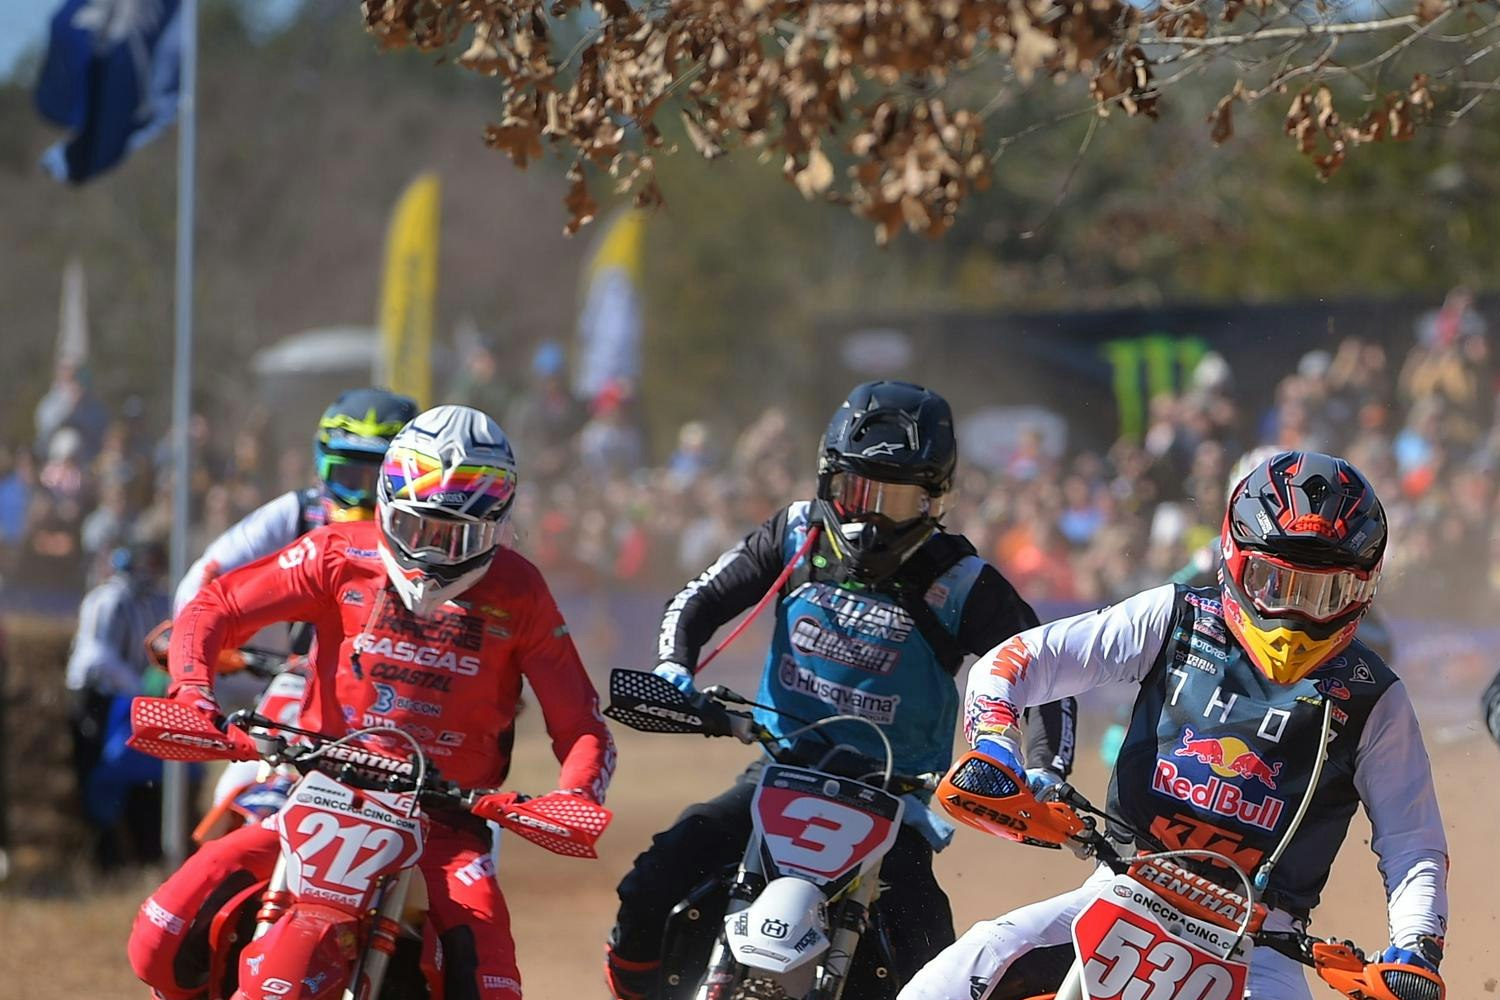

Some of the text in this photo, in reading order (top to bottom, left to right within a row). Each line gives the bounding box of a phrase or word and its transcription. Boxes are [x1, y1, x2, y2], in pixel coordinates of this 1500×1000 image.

[353, 632, 481, 677] GASGAS
[797, 671, 893, 713] Husqvarna
[946, 795, 1028, 832] ACERBIS
[1153, 759, 1285, 832] Red Bull
[296, 812, 404, 891] 212
[766, 797, 875, 873] 3
